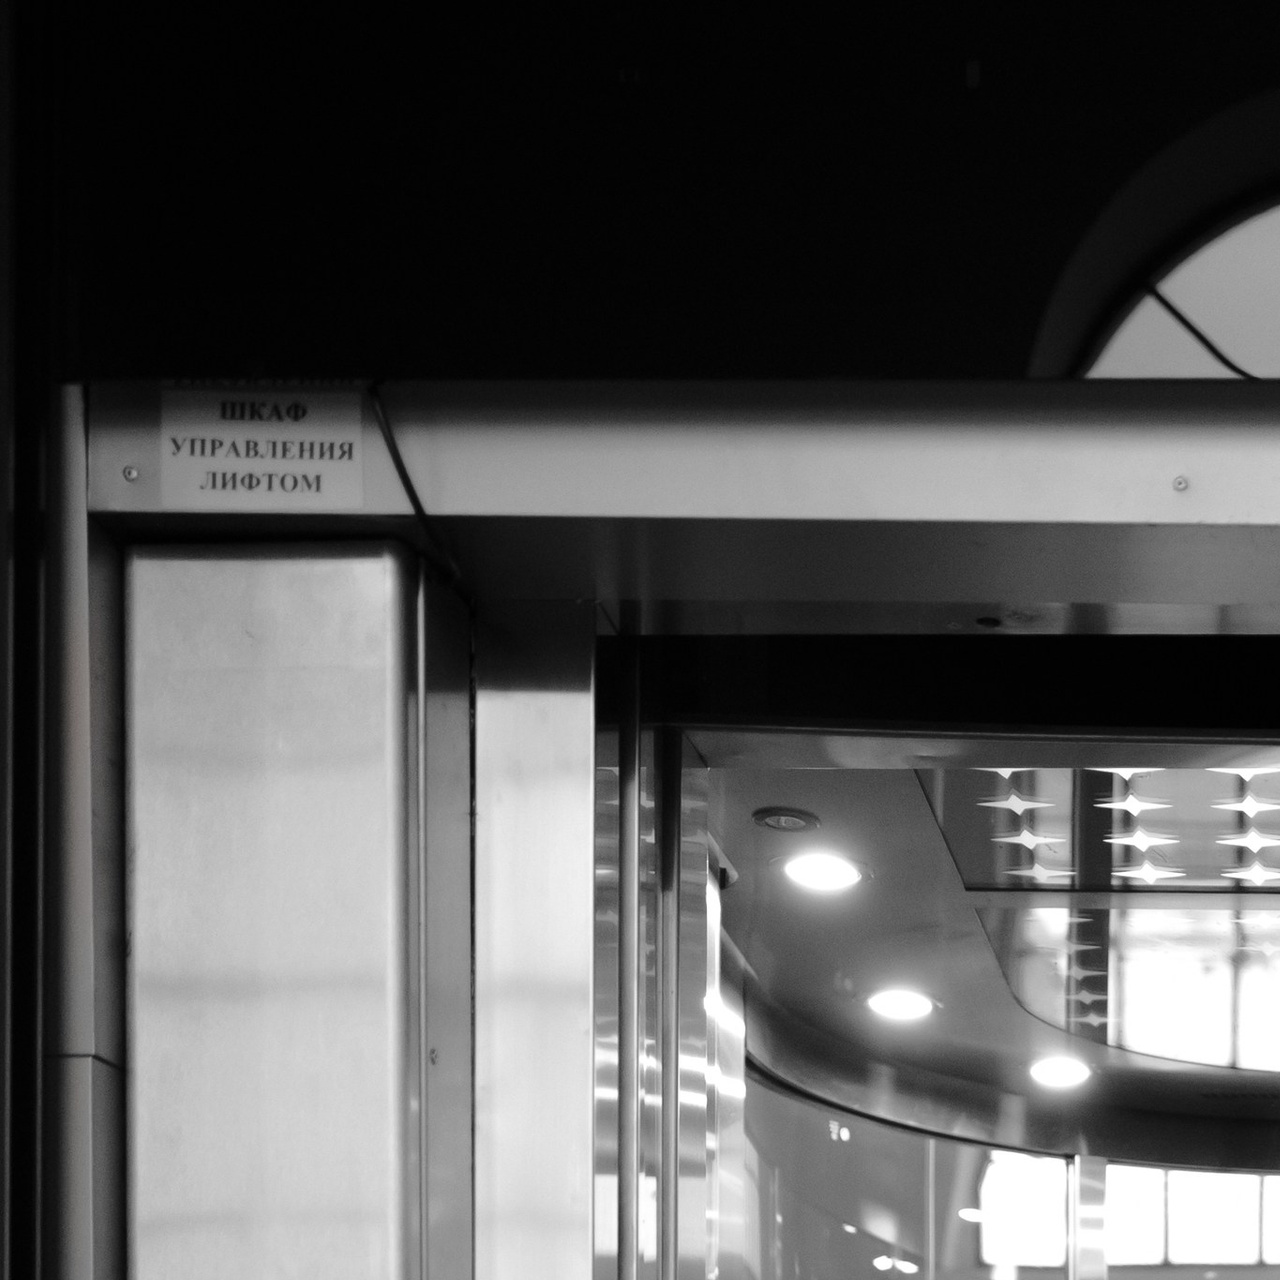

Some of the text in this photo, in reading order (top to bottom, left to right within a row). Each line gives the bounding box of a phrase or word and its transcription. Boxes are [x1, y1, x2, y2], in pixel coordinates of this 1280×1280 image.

[219, 401, 309, 422] ШКАФ
[169, 437, 355, 461] УПРАВЛЕНИЯ
[199, 470, 322, 494] ЛИФТОМ
